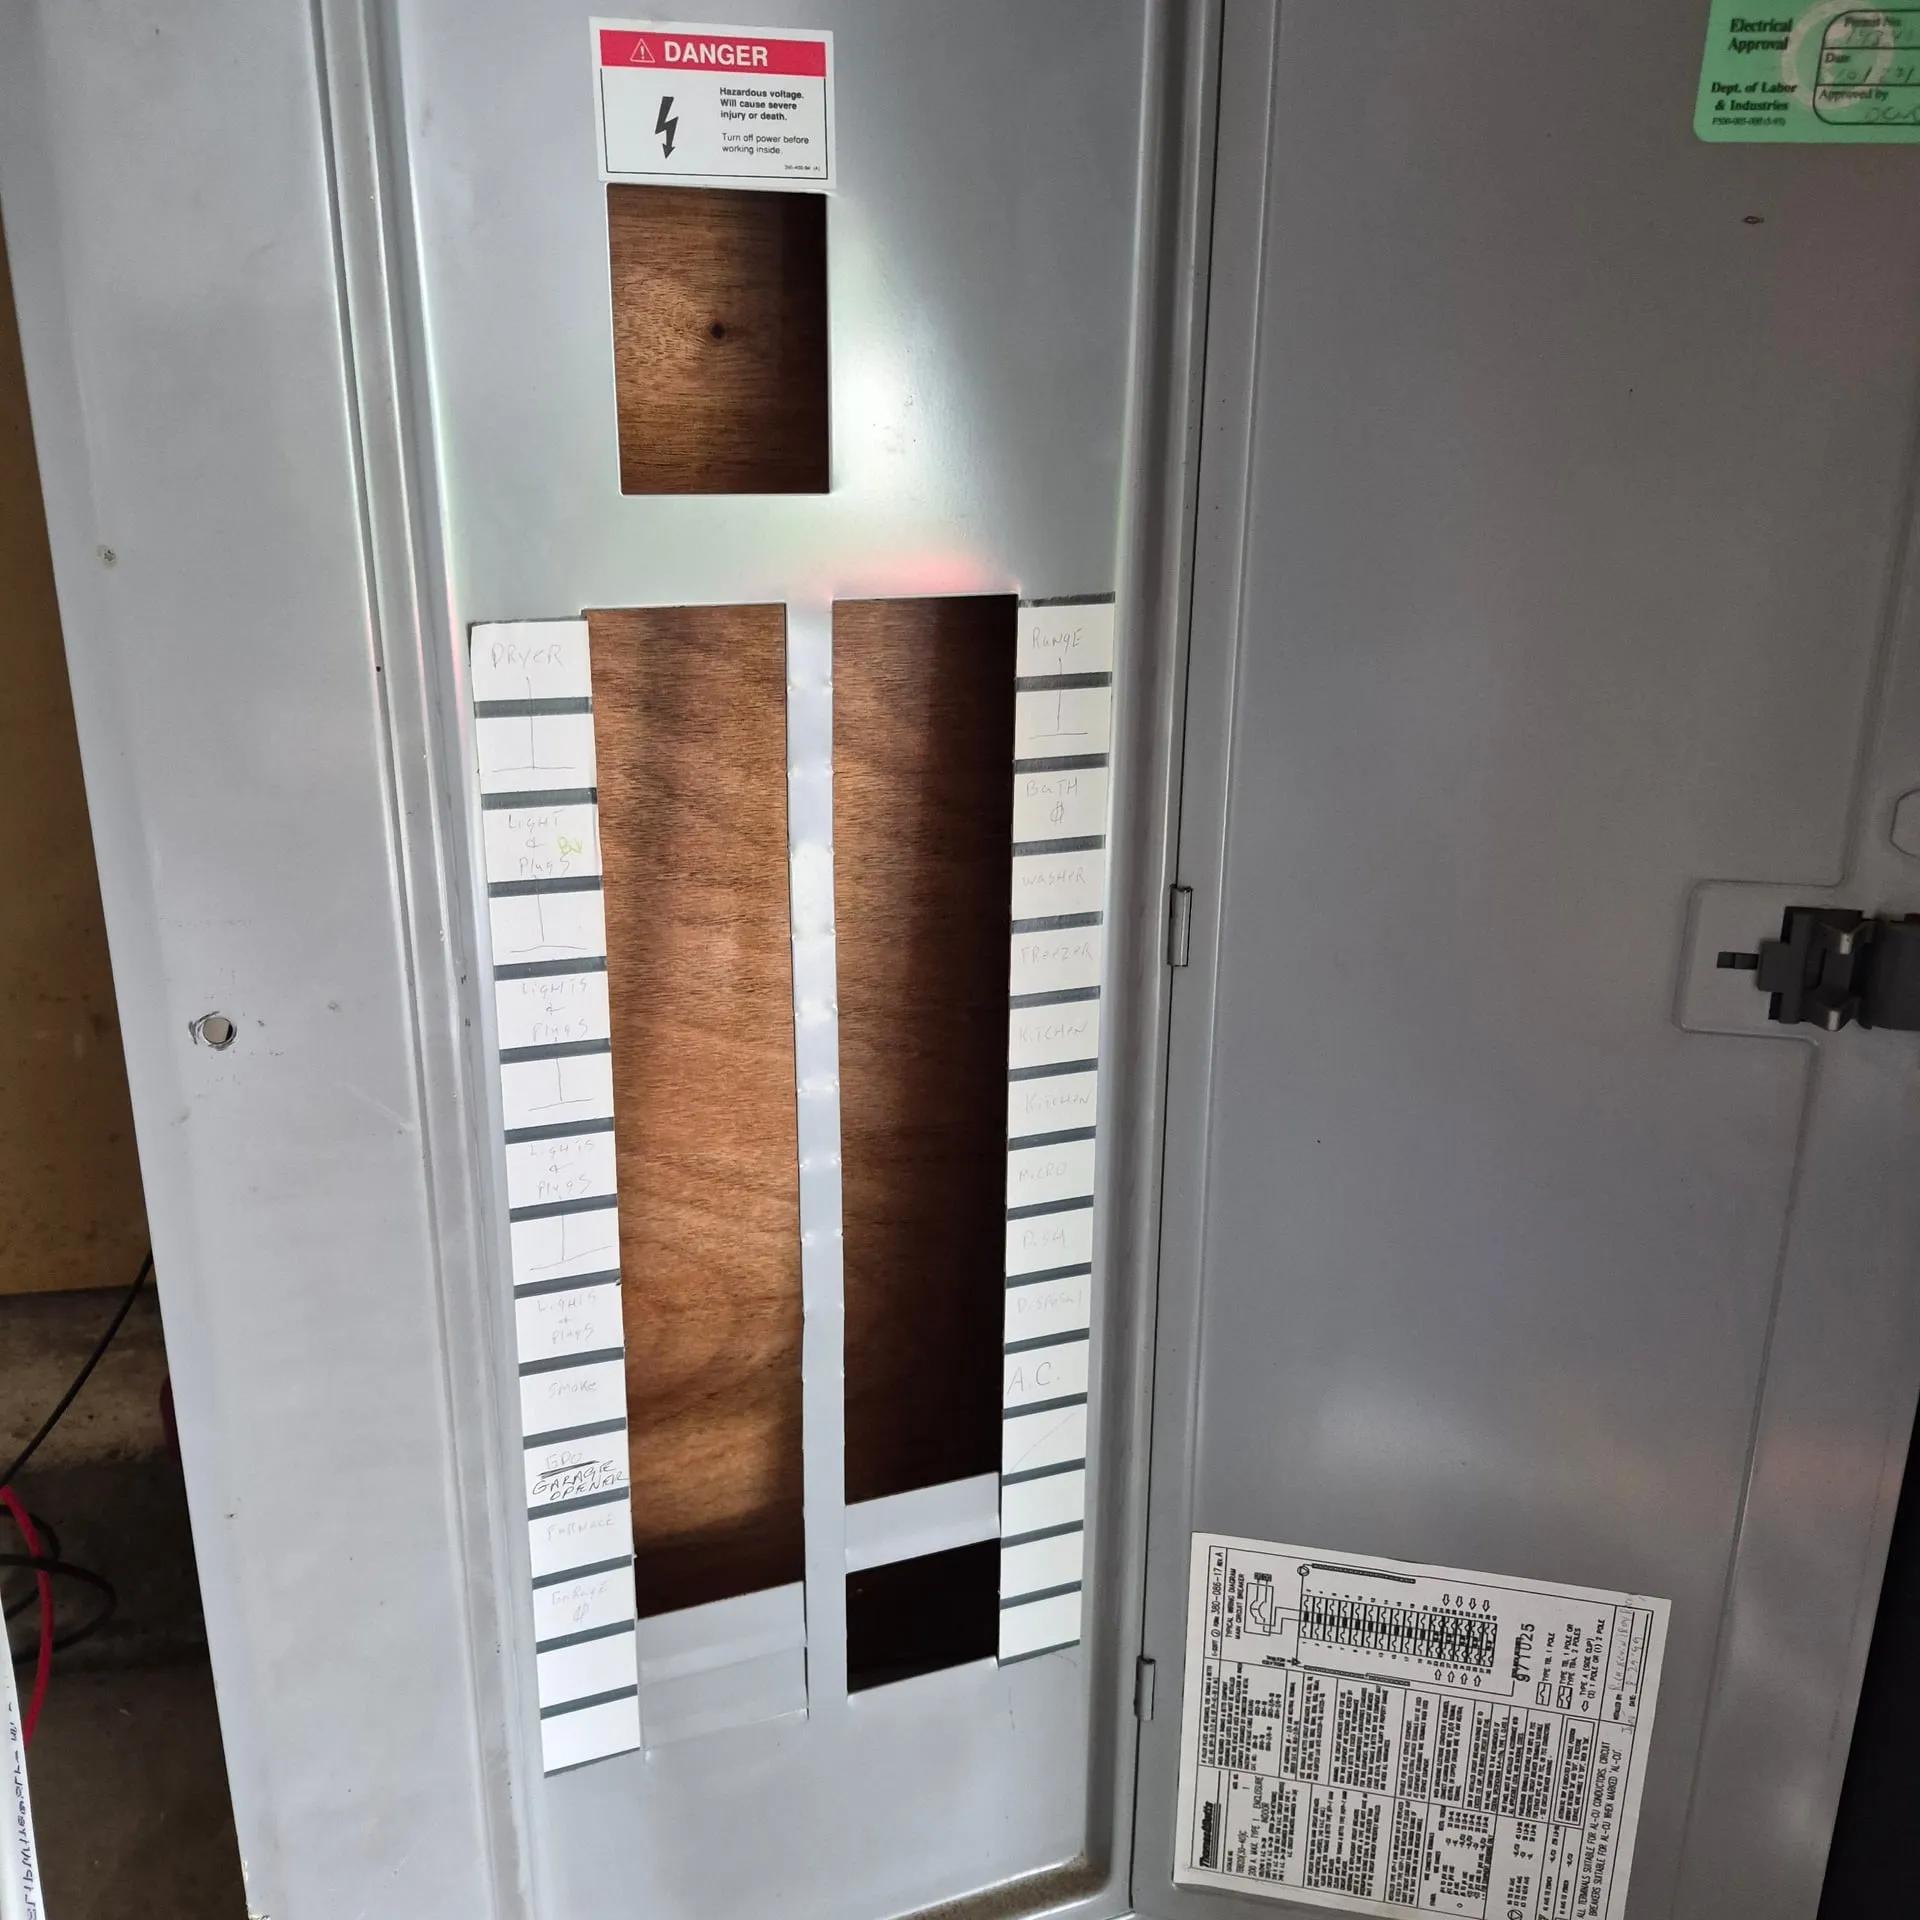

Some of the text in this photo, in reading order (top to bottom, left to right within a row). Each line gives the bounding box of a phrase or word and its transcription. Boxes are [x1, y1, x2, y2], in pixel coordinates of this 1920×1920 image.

[1730, 18, 1793, 33] Electrical
[1728, 37, 1789, 54] Approval
[664, 41, 768, 67] DANGER
[719, 87, 804, 100] Hazardous voltage.
[1711, 82, 1797, 95] Dept. of Labor
[720, 99, 797, 110] Will cause severe
[1715, 101, 1789, 111] & Industries
[720, 111, 746, 121] injury
[760, 112, 787, 120] death.
[722, 133, 809, 145] Turn off power before
[722, 145, 754, 154] working
[1228, 1567, 1236, 1592] DIAGRAM
[1236, 1573, 1244, 1599] BREAKER
[1235, 1601, 1243, 1624] CIRCUIT
[1225, 1615, 1233, 1637] TYPICAL
[1566, 1623, 1574, 1632] OR
[1596, 1618, 1605, 1634] POLE
[1564, 1633, 1572, 1650] POLE
[1514, 1621, 1536, 1682] 971025
[1542, 1667, 1550, 1681] TYPE
[1546, 1631, 1555, 1647] POLE
[1566, 1671, 1575, 1685] TYPE
[1572, 1627, 1581, 1646] POLES
[1592, 1654, 1599, 1663] OR
[1559, 1670, 1568, 1684] TYPE
[1589, 1665, 1598, 1681] POLE
[1579, 1680, 1588, 1696] TYPE
[1598, 1740, 1611, 1764] CIRCUIT
[1253, 1776, 1263, 1809] ENCLOSURE
[1605, 1775, 1618, 1800] MARKED
[1603, 1802, 1614, 1818] WHEN
[1586, 1831, 1597, 1844] FOR
[1597, 1843, 1608, 1856] FOR
[1582, 1845, 1595, 1873] SUITABLE
[1592, 1857, 1605, 1885] SUITABLE
[1588, 1885, 1601, 1916] BREAKERS
[1575, 1907, 1586, 1918] ALL
